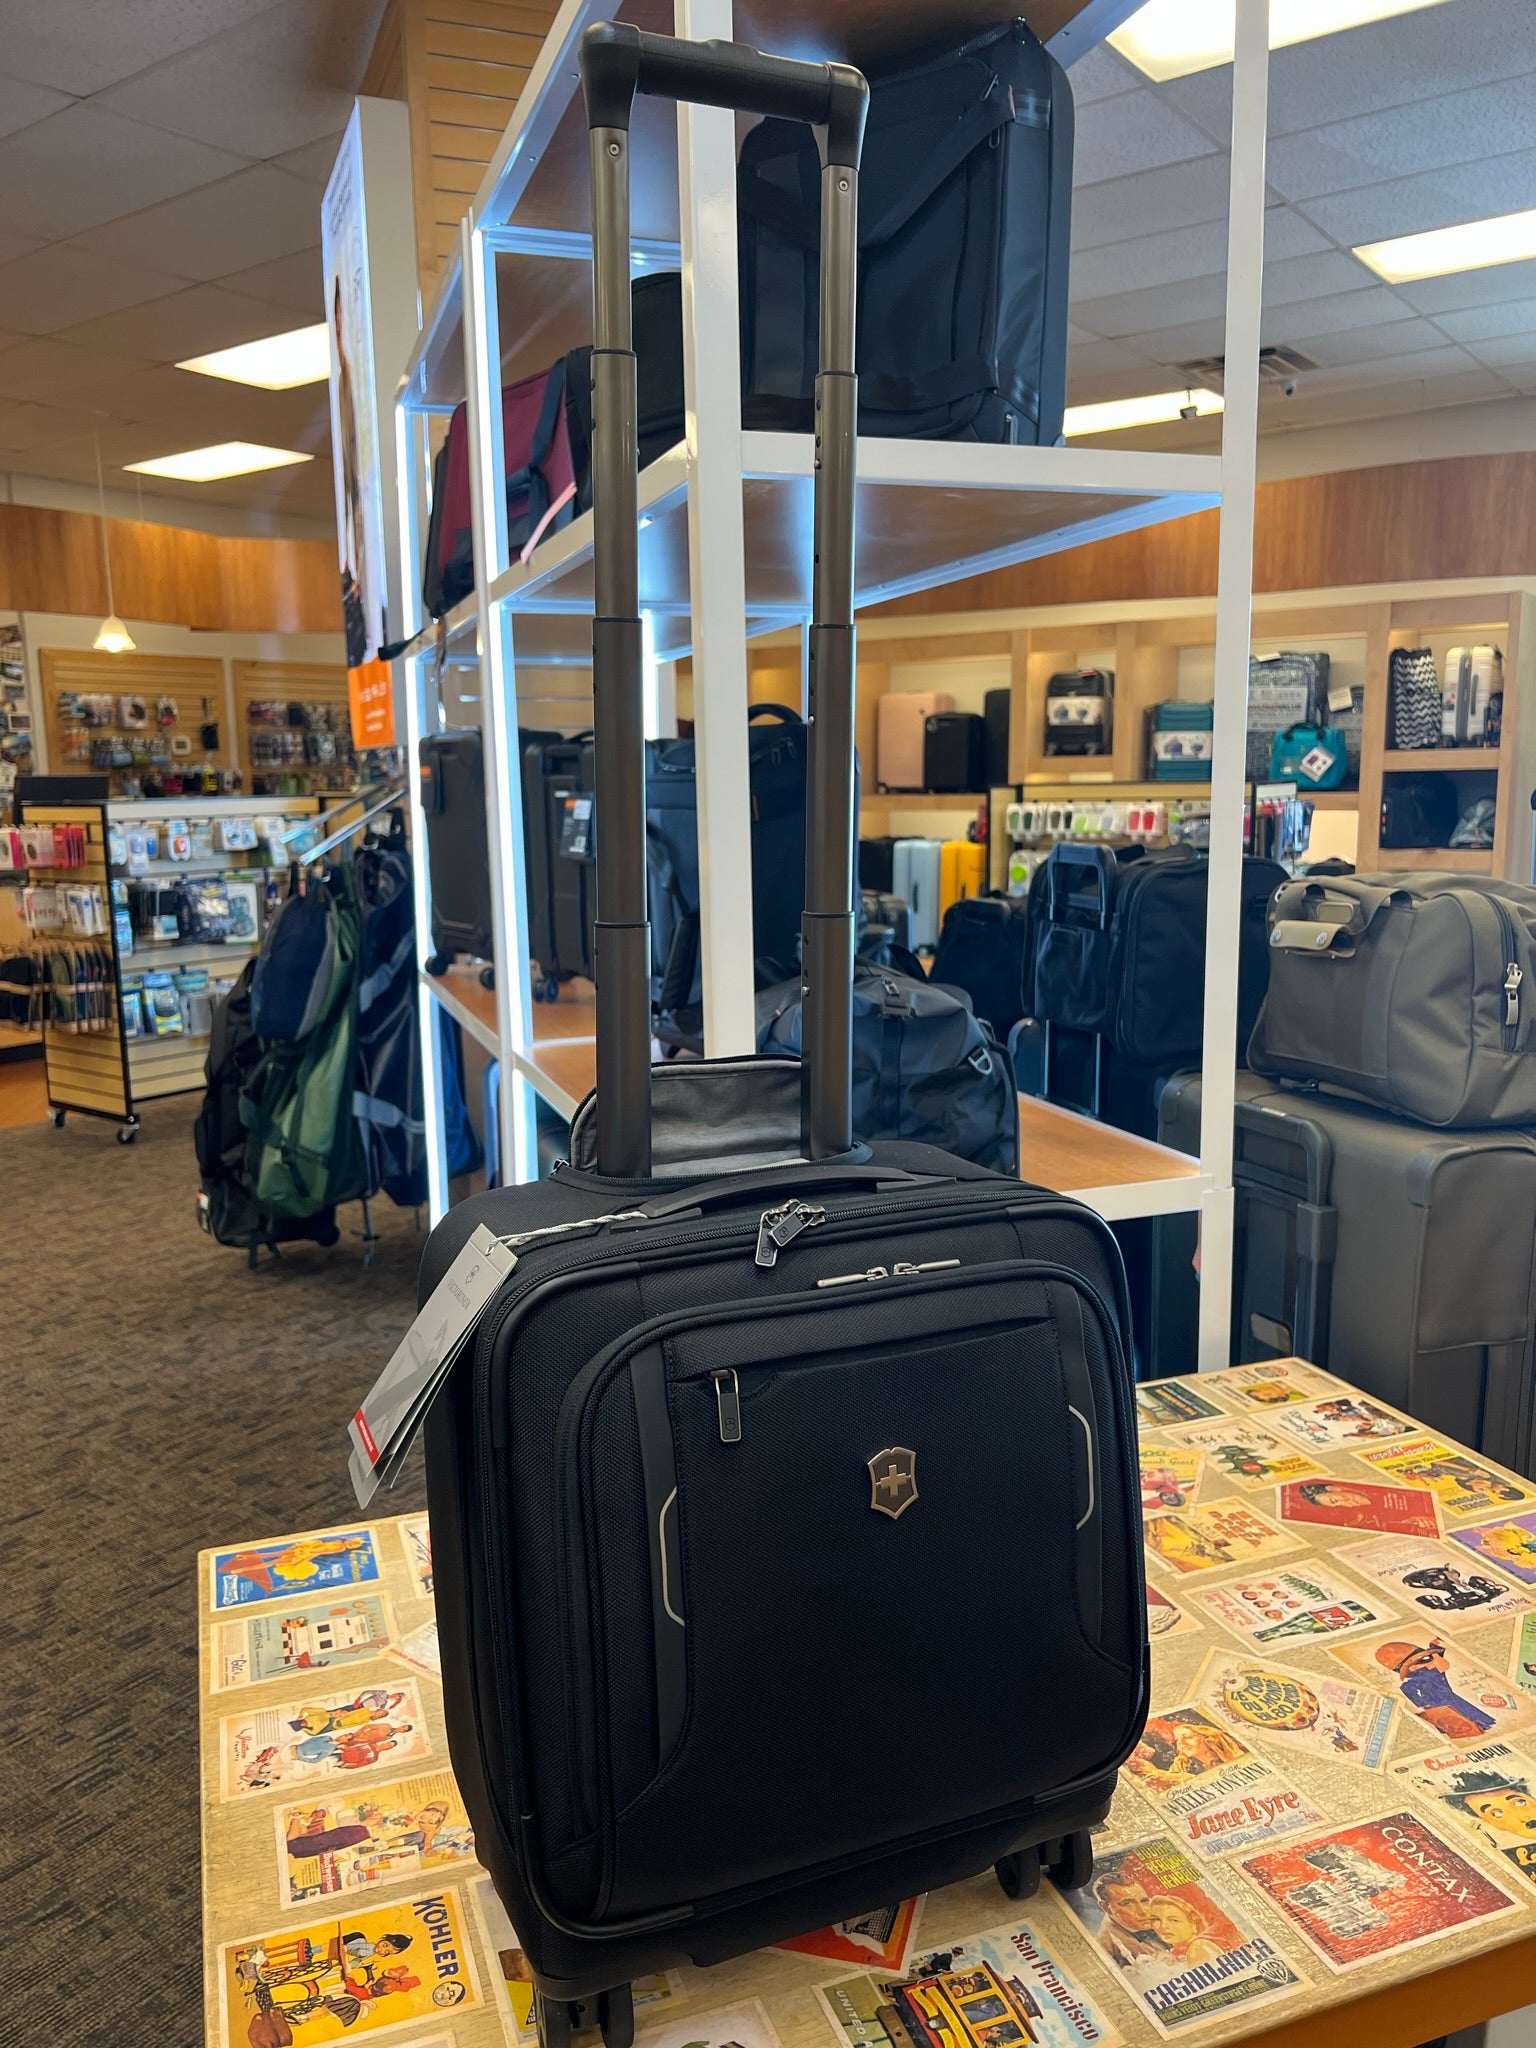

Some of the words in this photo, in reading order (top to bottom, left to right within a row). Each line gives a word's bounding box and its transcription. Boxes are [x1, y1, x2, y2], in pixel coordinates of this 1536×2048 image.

[1240, 1699, 1262, 1712] DU
[1260, 1677, 1282, 1707] MONDE
[1271, 1704, 1293, 1720] 80
[1424, 1753, 1469, 1772] Charlie
[1467, 1742, 1512, 1764] CHAPLIN
[1161, 1787, 1215, 1815] WELLES
[1213, 1762, 1272, 1797] FONTAINE
[1186, 1804, 1245, 1840] Jane
[1246, 1790, 1301, 1826] Eyre
[320, 1852, 334, 1893] Budweiser
[1381, 1826, 1476, 1903] CONTAX
[412, 1895, 459, 1979] KÖHLER
[1010, 1930, 1039, 1960] San
[1031, 1959, 1100, 2041] Francisco
[1144, 1938, 1275, 2012] CASABLANCA
[836, 1990, 867, 2037] UNITED
